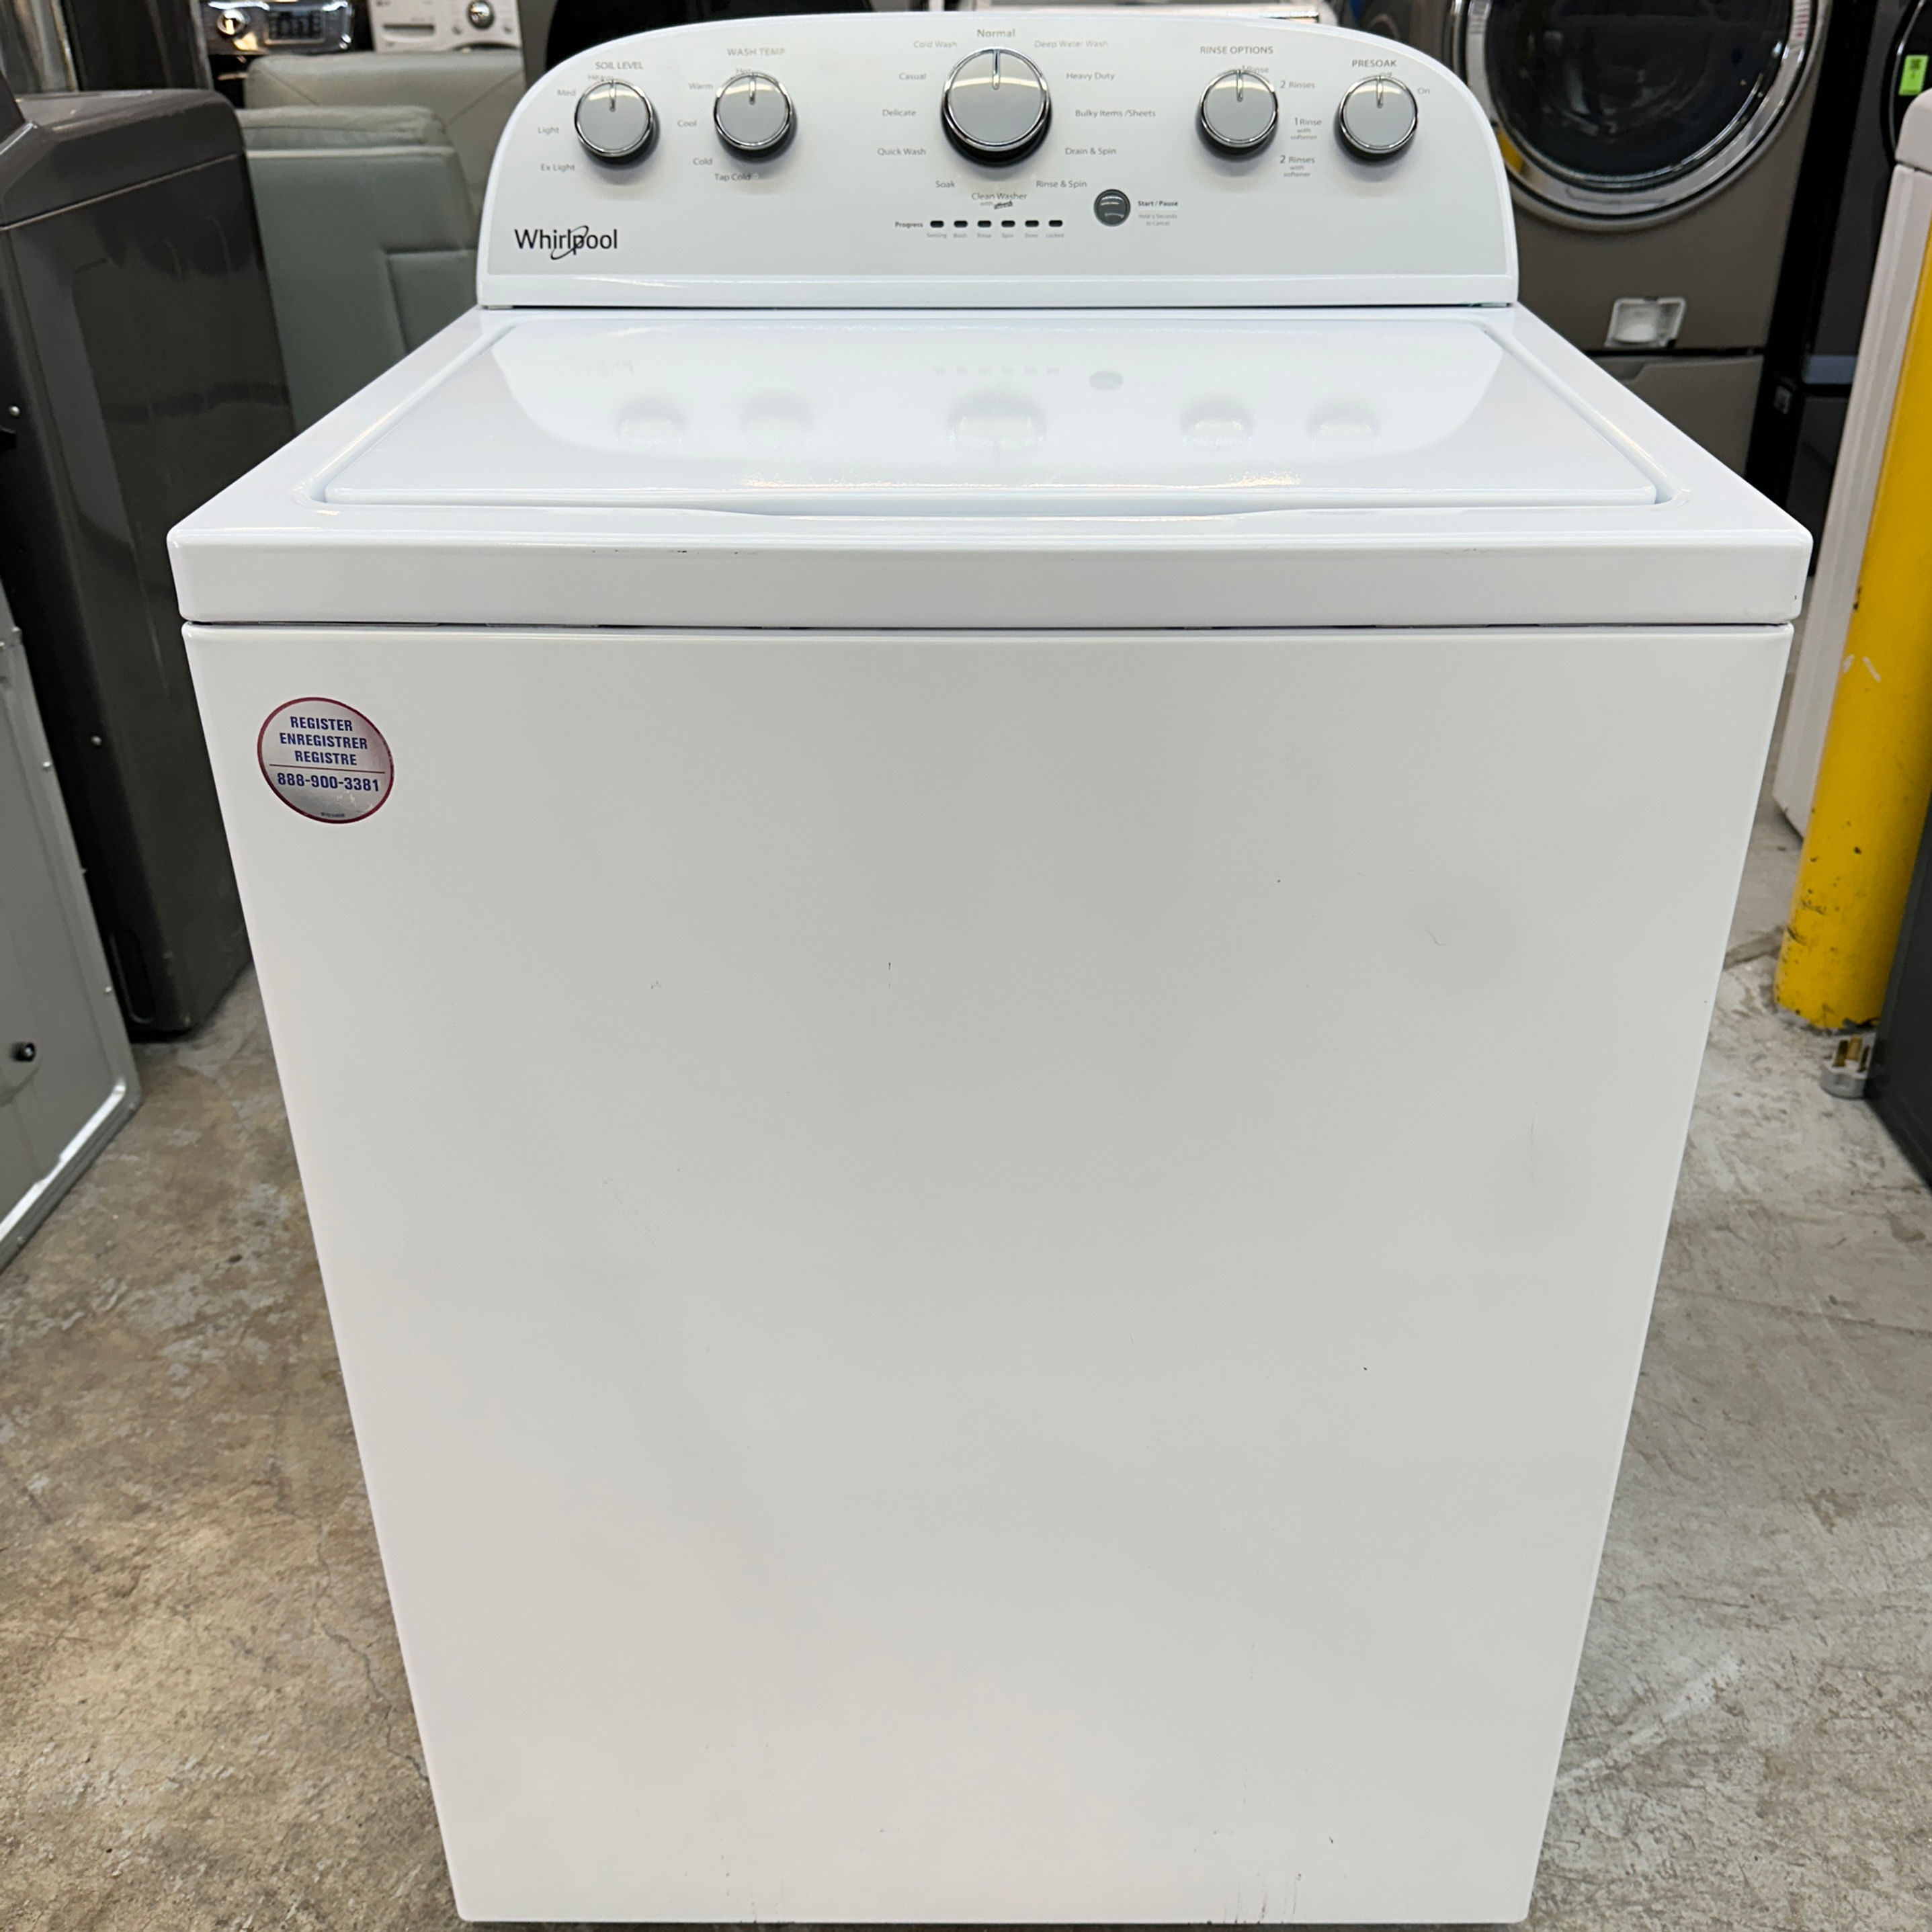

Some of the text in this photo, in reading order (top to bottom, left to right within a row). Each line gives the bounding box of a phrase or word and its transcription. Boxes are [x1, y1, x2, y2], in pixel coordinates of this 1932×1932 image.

[977, 29, 1015, 38] Normal
[1035, 40, 1057, 49] Deep
[727, 48, 785, 56] WASH TEMP
[595, 61, 644, 70] SOIL LEVEL
[1352, 59, 1397, 67] PRESOAK
[899, 73, 927, 81] Casual
[1066, 73, 1115, 81] Heavy Duty
[1280, 81, 1286, 89] 2
[1075, 110, 1098, 118] Bulky
[677, 120, 698, 128] Cool
[538, 126, 560, 135] Light
[877, 148, 902, 156] Quick
[1065, 147, 1117, 156] Drain & Spin
[1279, 155, 1315, 164] 2 Rinses
[540, 163, 575, 173] Ex Light
[714, 173, 751, 181] Tap Cold
[935, 180, 956, 188] Soak
[1036, 180, 1087, 189] Rinse & Spin
[971, 192, 1027, 200] Clean Washer
[895, 221, 923, 229] Progress
[514, 227, 618, 258] Whirlpool
[290, 716, 353, 731] REGISTER
[279, 732, 368, 749] ENREGISTRER
[294, 751, 358, 765] REGISTRE
[277, 772, 379, 792] 888-900-3381
